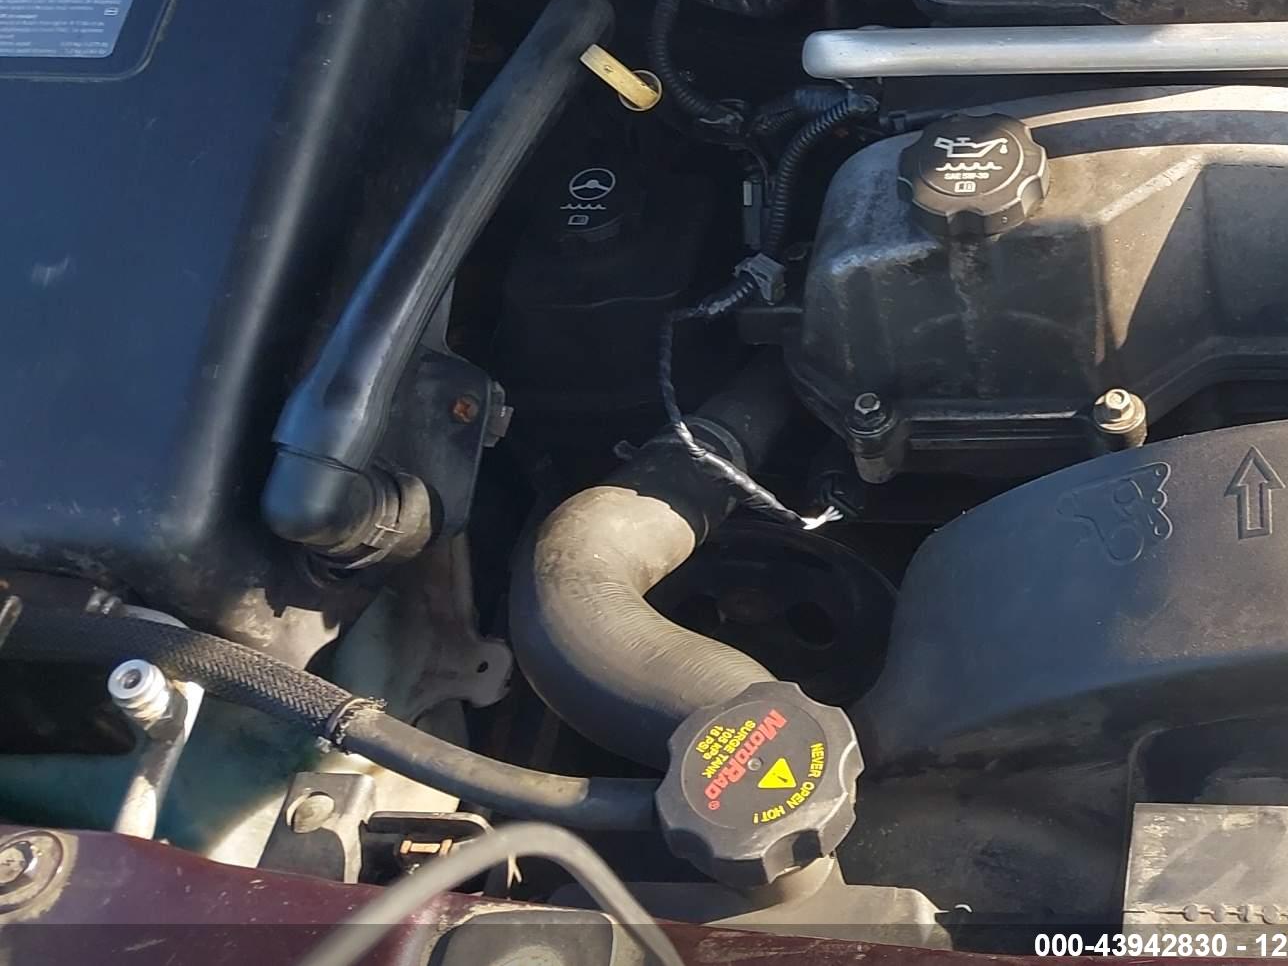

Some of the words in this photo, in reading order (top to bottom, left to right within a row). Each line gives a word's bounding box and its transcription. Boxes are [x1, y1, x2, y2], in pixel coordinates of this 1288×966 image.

[695, 735, 715, 753] PSI
[723, 720, 757, 754] SURGE
[701, 753, 729, 779] TANK
[808, 743, 824, 778] NEVER
[787, 782, 815, 809] OPEN
